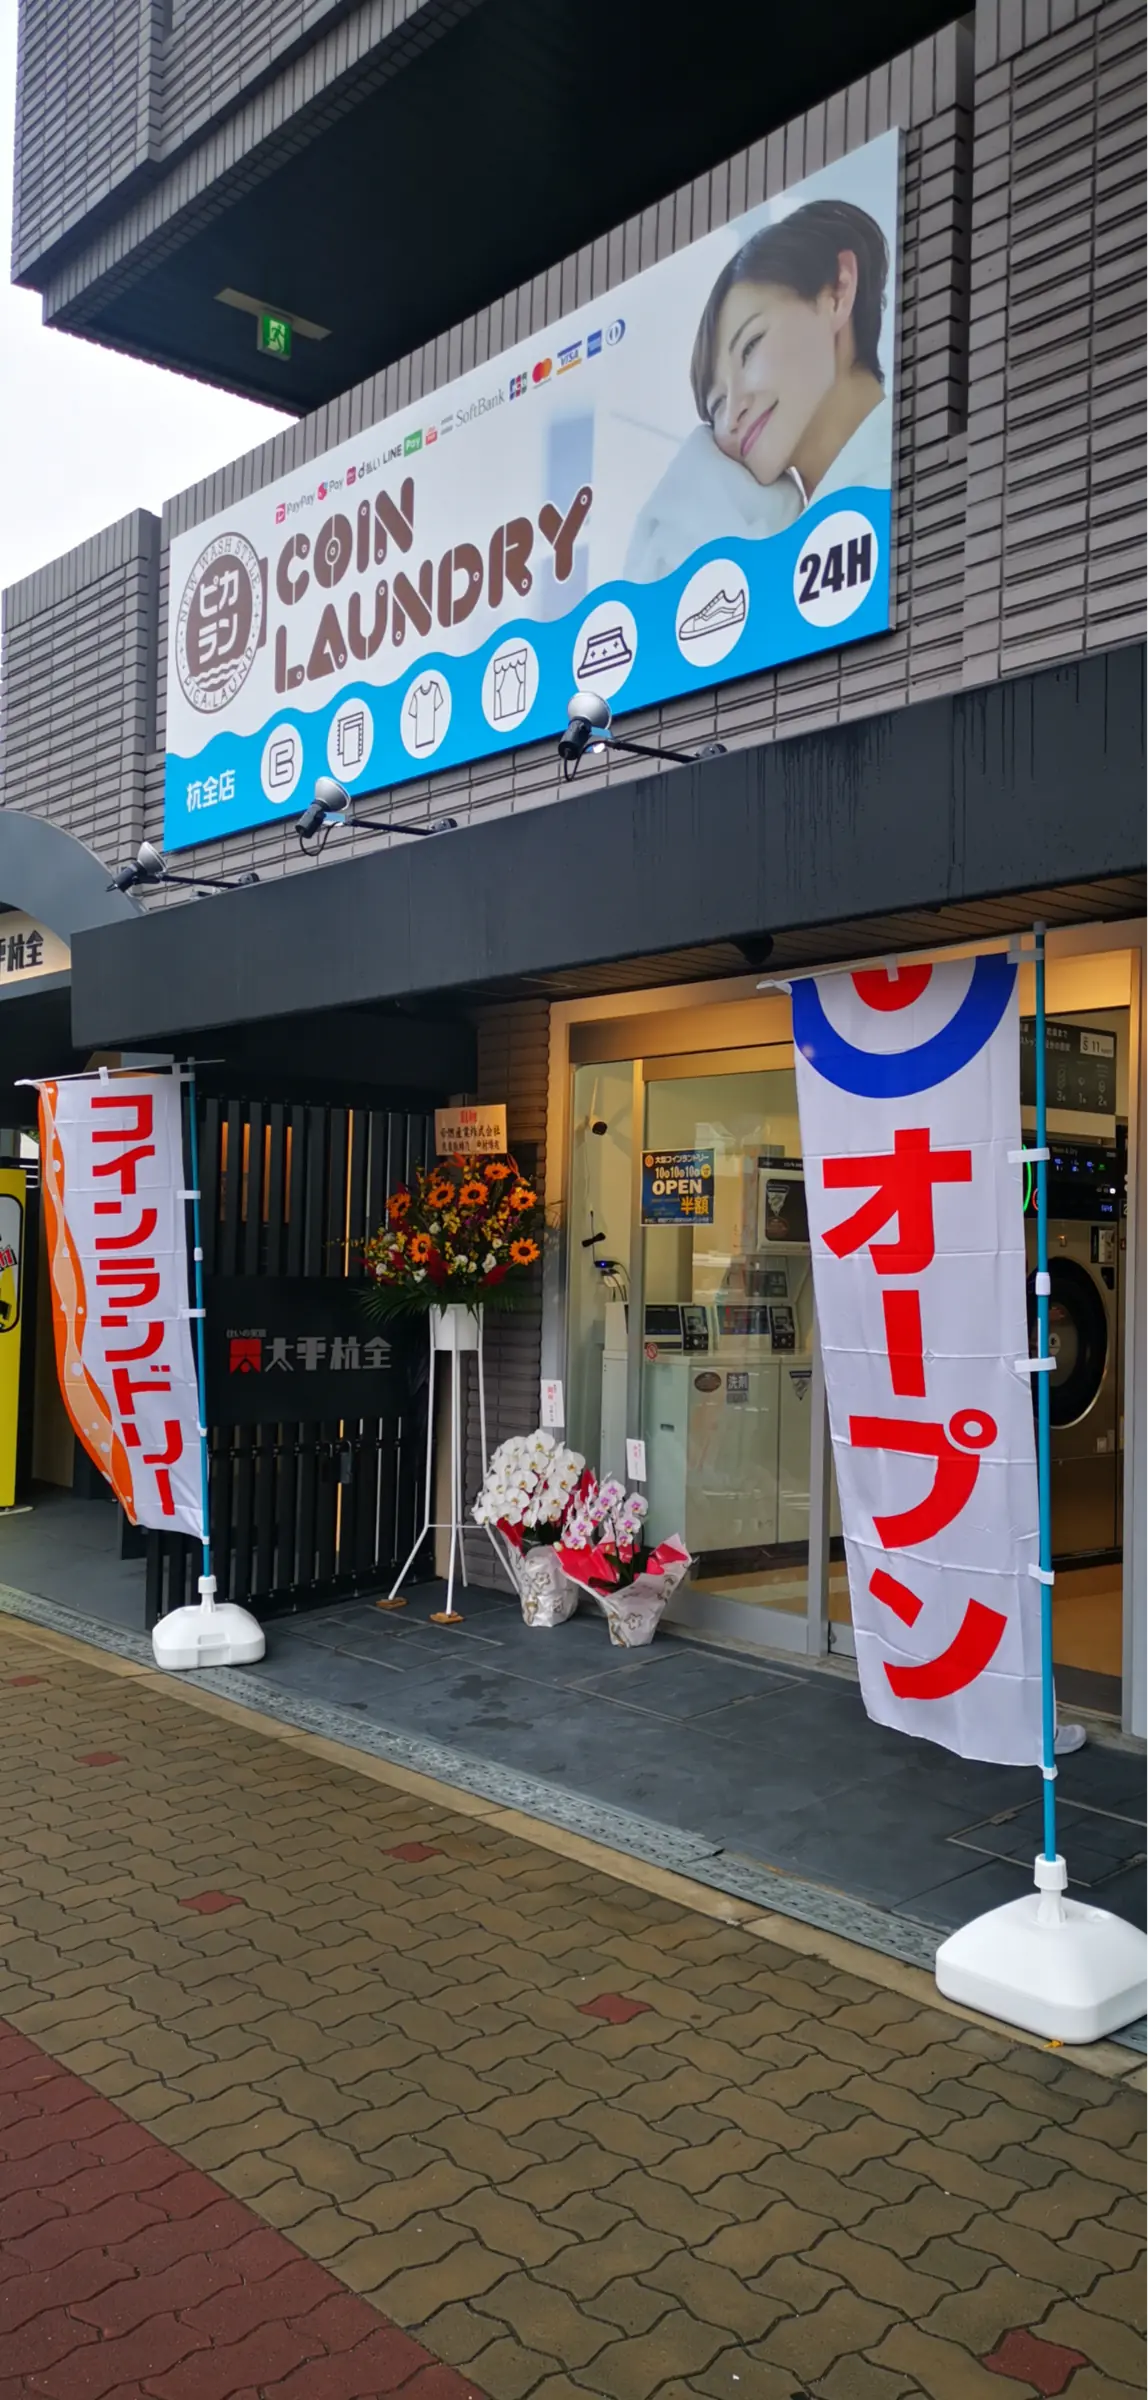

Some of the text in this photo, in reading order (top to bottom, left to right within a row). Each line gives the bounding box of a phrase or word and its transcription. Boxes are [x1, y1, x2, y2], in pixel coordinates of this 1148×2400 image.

[560, 349, 579, 366] VISA
[455, 388, 505, 428] SoftBank
[383, 444, 402, 464] LINE
[276, 477, 414, 605] COIN
[199, 537, 232, 570] WASH
[234, 539, 262, 591] STYLE
[798, 533, 871, 604] 24H
[275, 486, 592, 693] LAUNDRY
[186, 769, 235, 812] 杭全店
[652, 1178, 702, 1196] OPEN
[681, 1195, 709, 1215] 半額
[91, 1094, 183, 1516] コインランドリー
[265, 1336, 392, 1372] 太平杭全
[821, 1127, 1007, 1700] オープン
